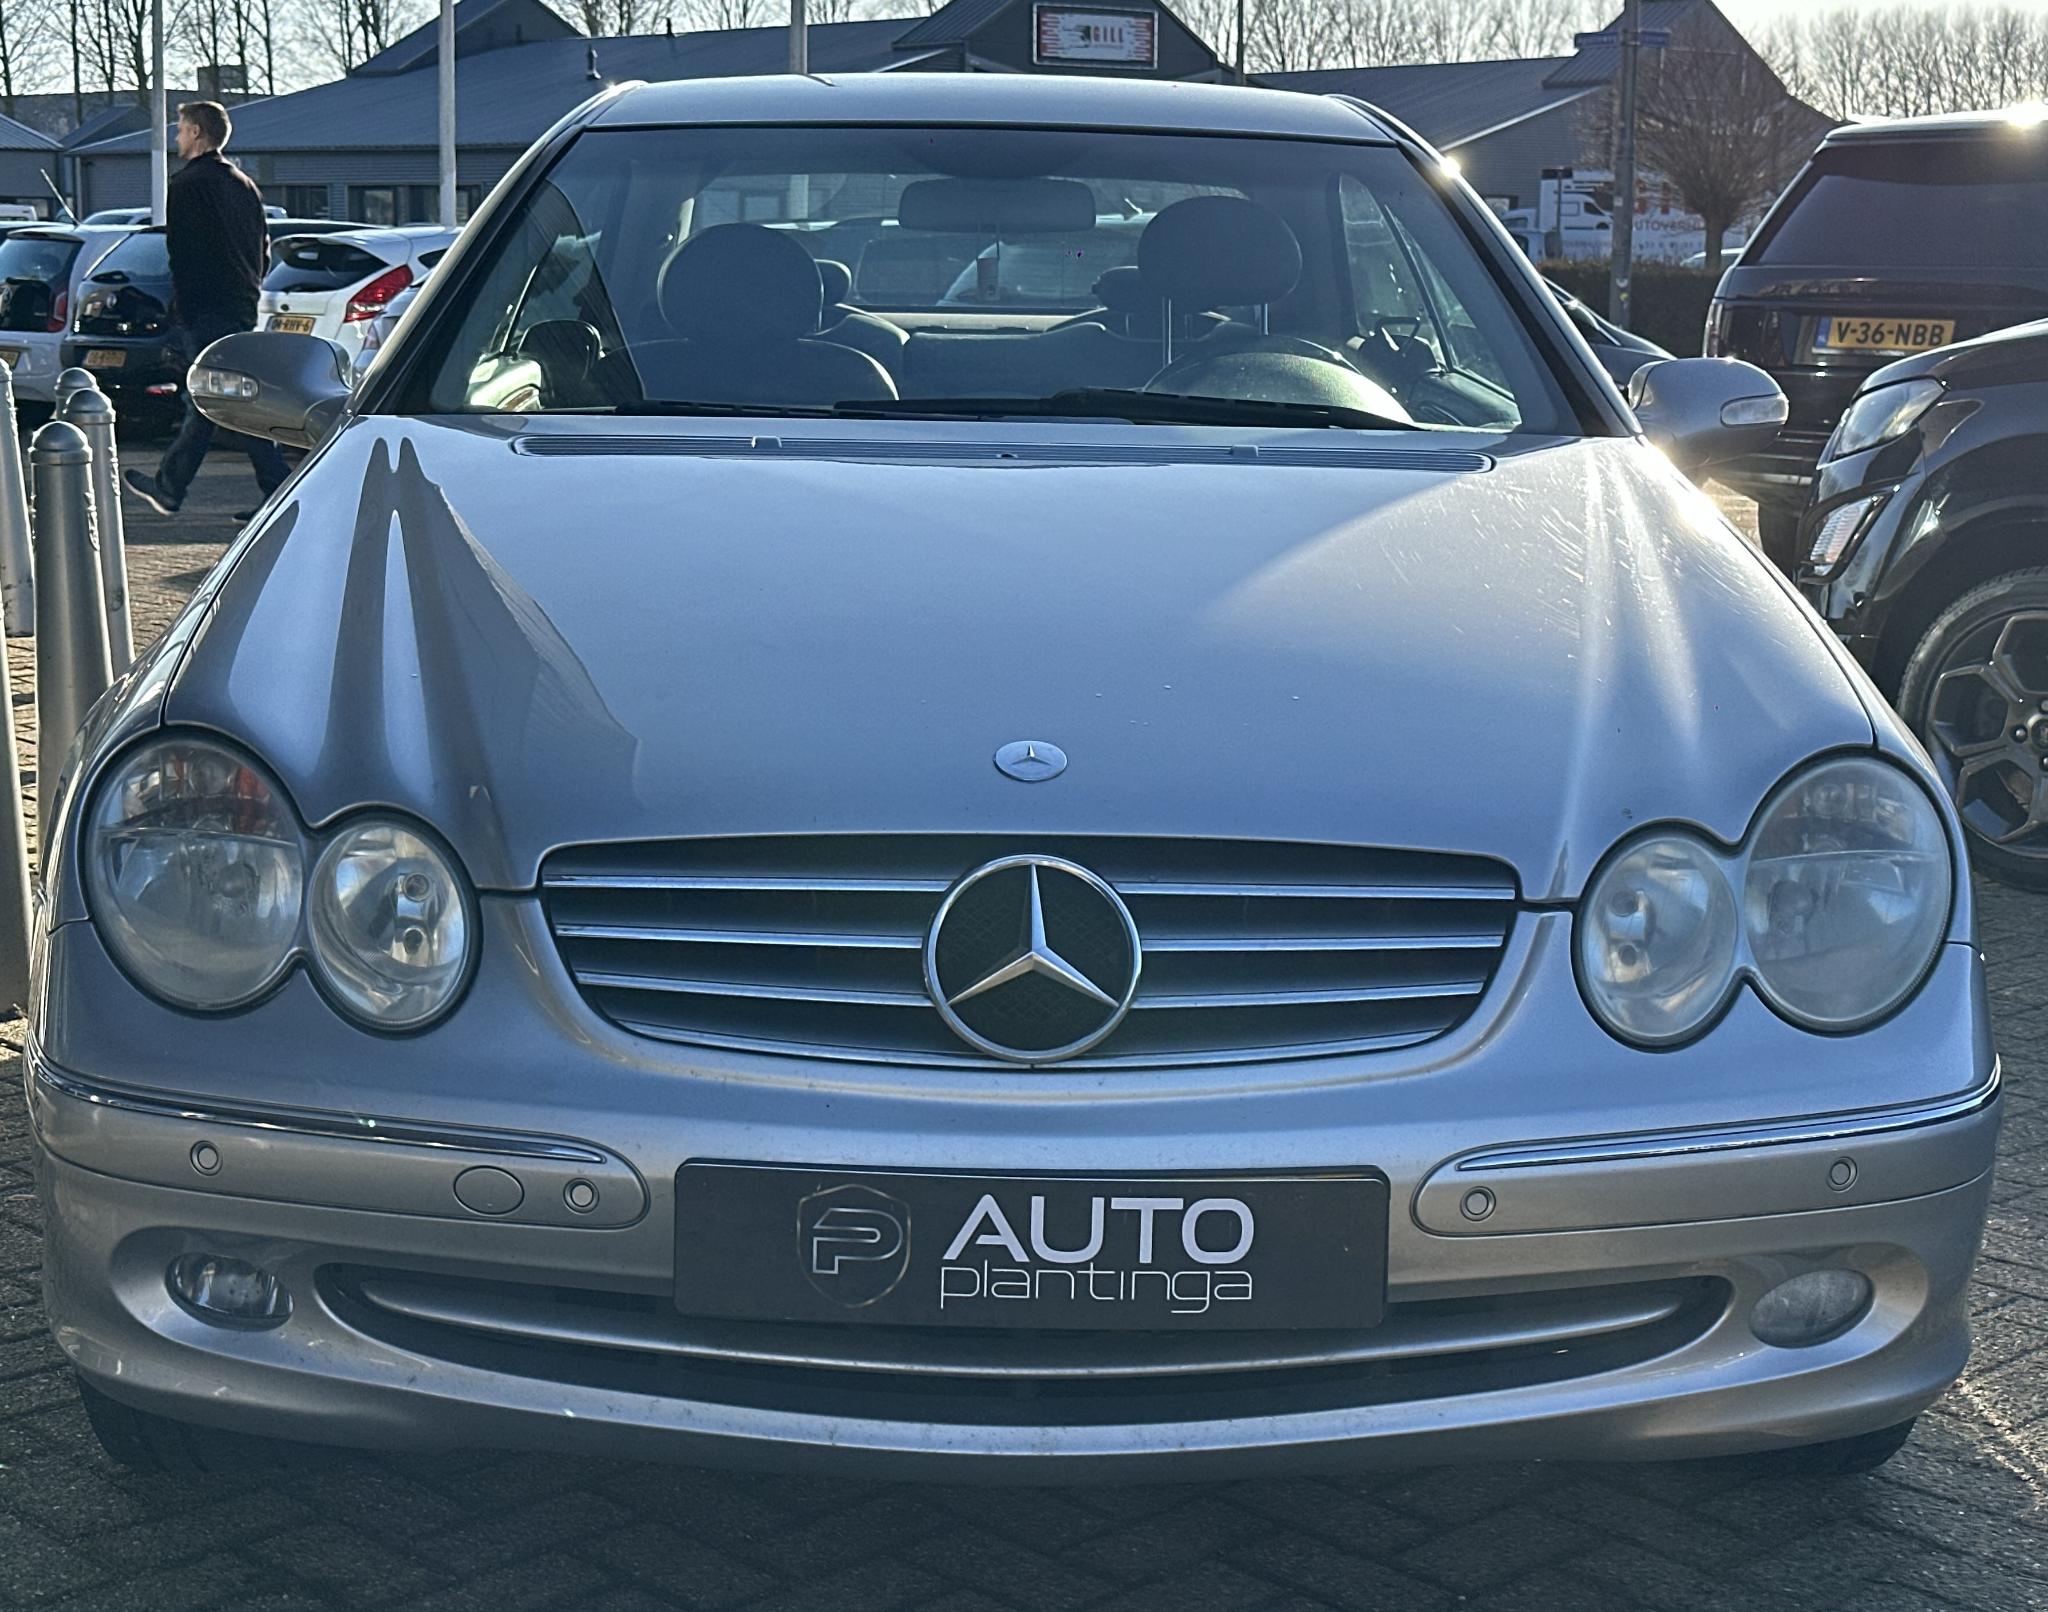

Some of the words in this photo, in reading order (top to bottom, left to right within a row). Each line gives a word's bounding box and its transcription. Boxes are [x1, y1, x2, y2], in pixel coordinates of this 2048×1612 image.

[1836, 321, 1945, 346] V-36-NBB
[941, 1194, 1255, 1265] AUTO
[940, 1258, 1254, 1313] plantinga
